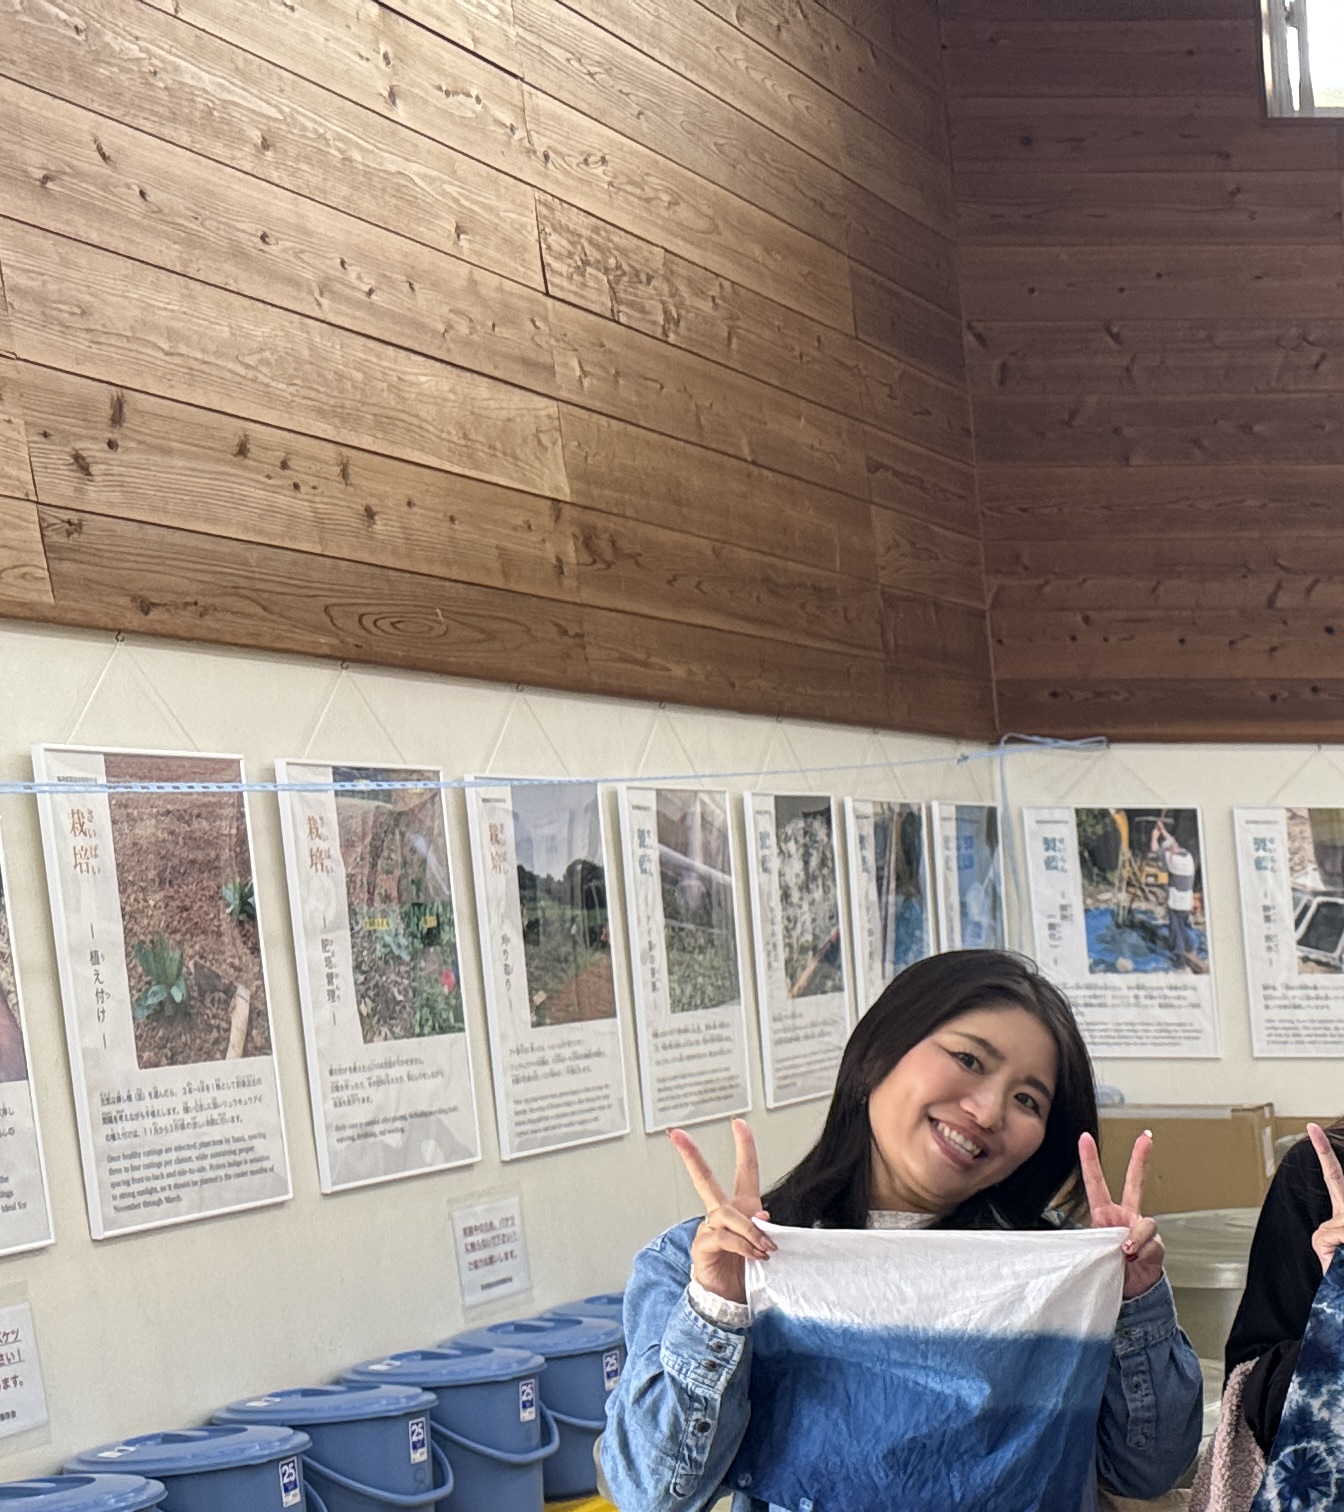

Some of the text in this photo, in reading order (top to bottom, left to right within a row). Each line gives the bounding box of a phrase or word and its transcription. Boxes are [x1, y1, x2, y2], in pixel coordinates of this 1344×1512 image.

[69, 808, 90, 875] 栽培
[604, 1353, 618, 1371] 25
[520, 1382, 534, 1402] 25
[410, 1422, 424, 1441] 25
[282, 1462, 296, 1484] 25
